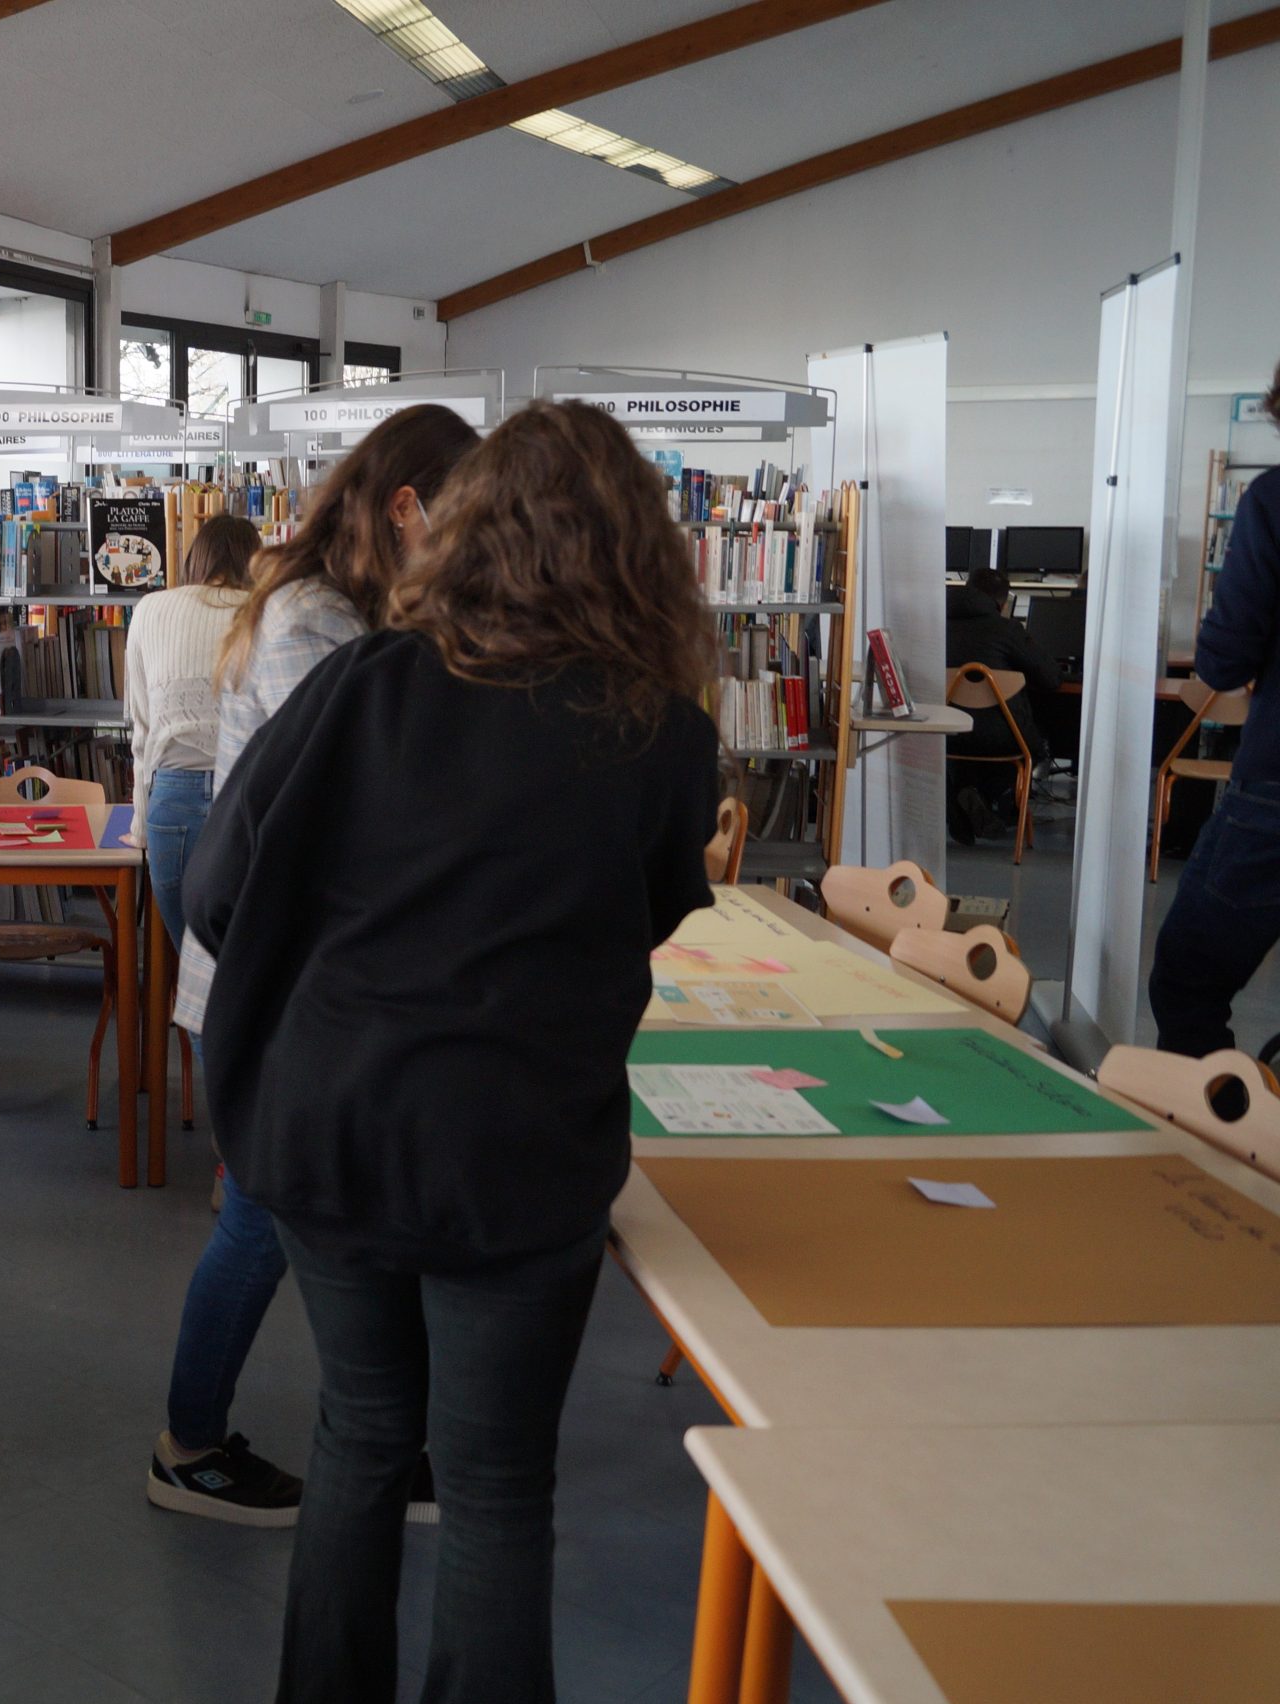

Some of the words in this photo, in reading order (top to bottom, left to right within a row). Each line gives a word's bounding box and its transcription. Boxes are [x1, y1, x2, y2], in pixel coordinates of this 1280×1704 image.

[627, 400, 741, 412] PHILOSOPHIE
[18, 411, 115, 423] PHILOSOPHIE
[304, 409, 328, 421] 100
[110, 506, 146, 515] PLATON
[107, 514, 119, 523] LA
